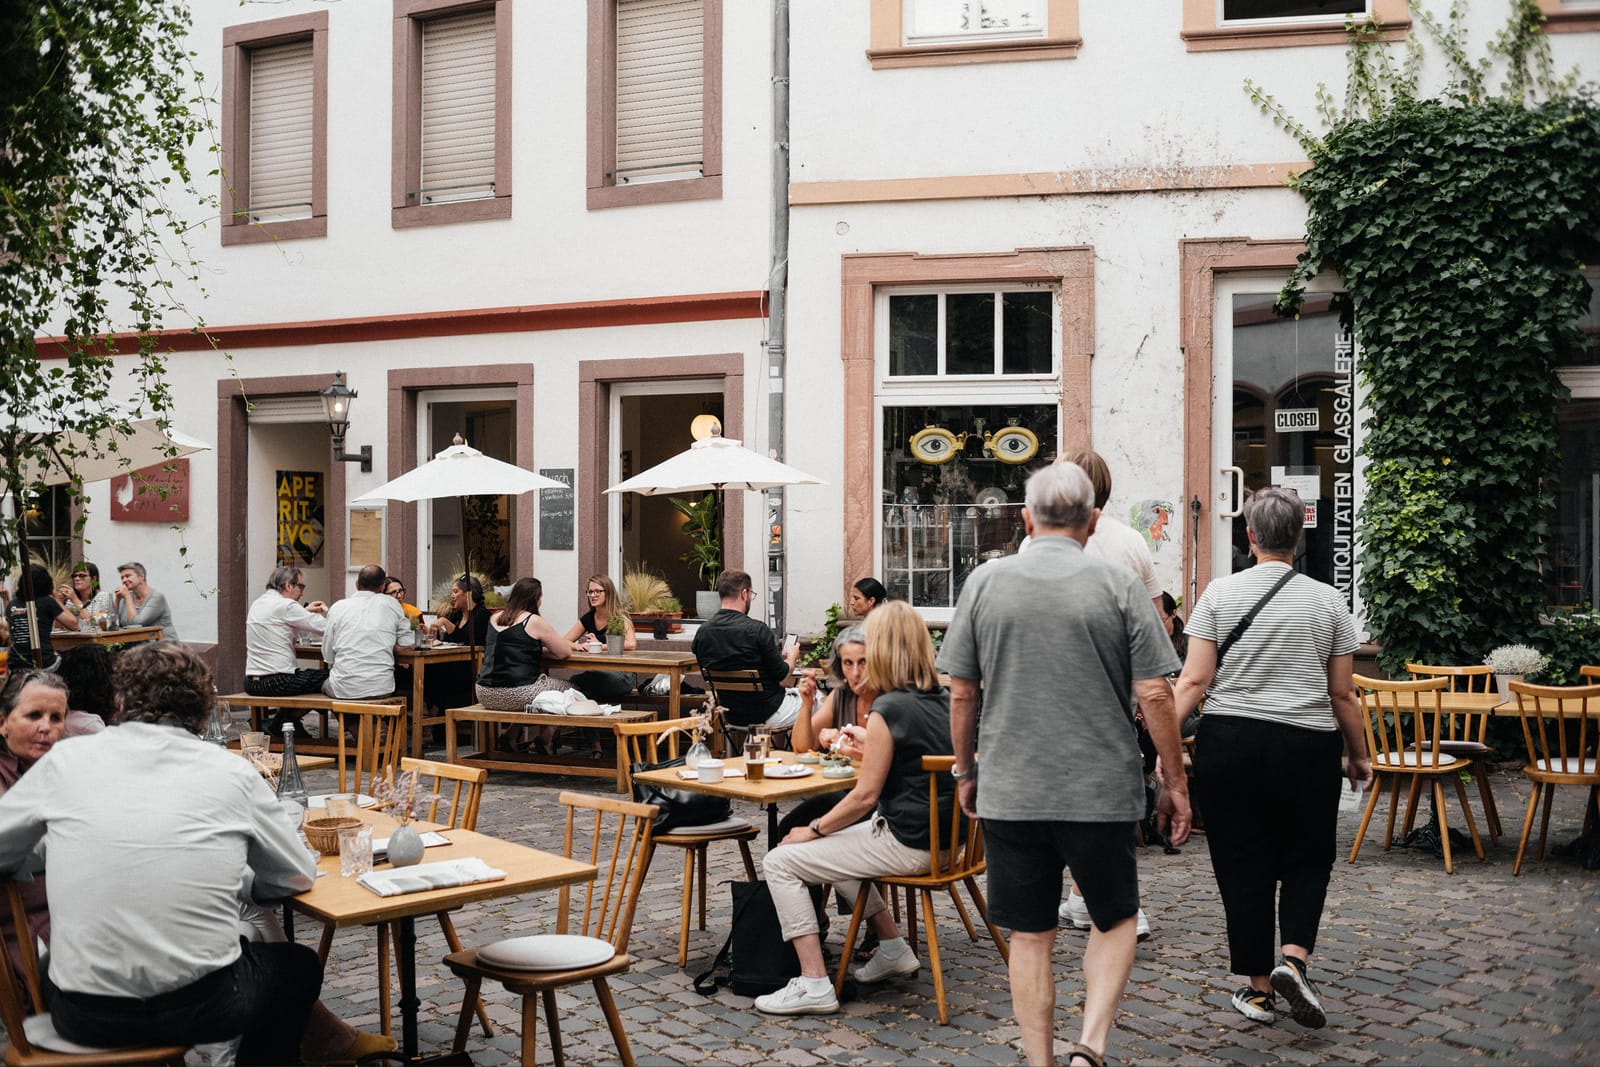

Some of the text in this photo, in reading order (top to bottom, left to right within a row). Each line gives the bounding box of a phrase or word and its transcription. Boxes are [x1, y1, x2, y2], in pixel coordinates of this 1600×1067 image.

[1277, 412, 1317, 427] CLOSED
[1333, 332, 1351, 608] NTIQUITATEN GLASGALERIE
[278, 475, 315, 497] APE
[279, 500, 309, 521] RIT
[279, 523, 315, 545] IVO
